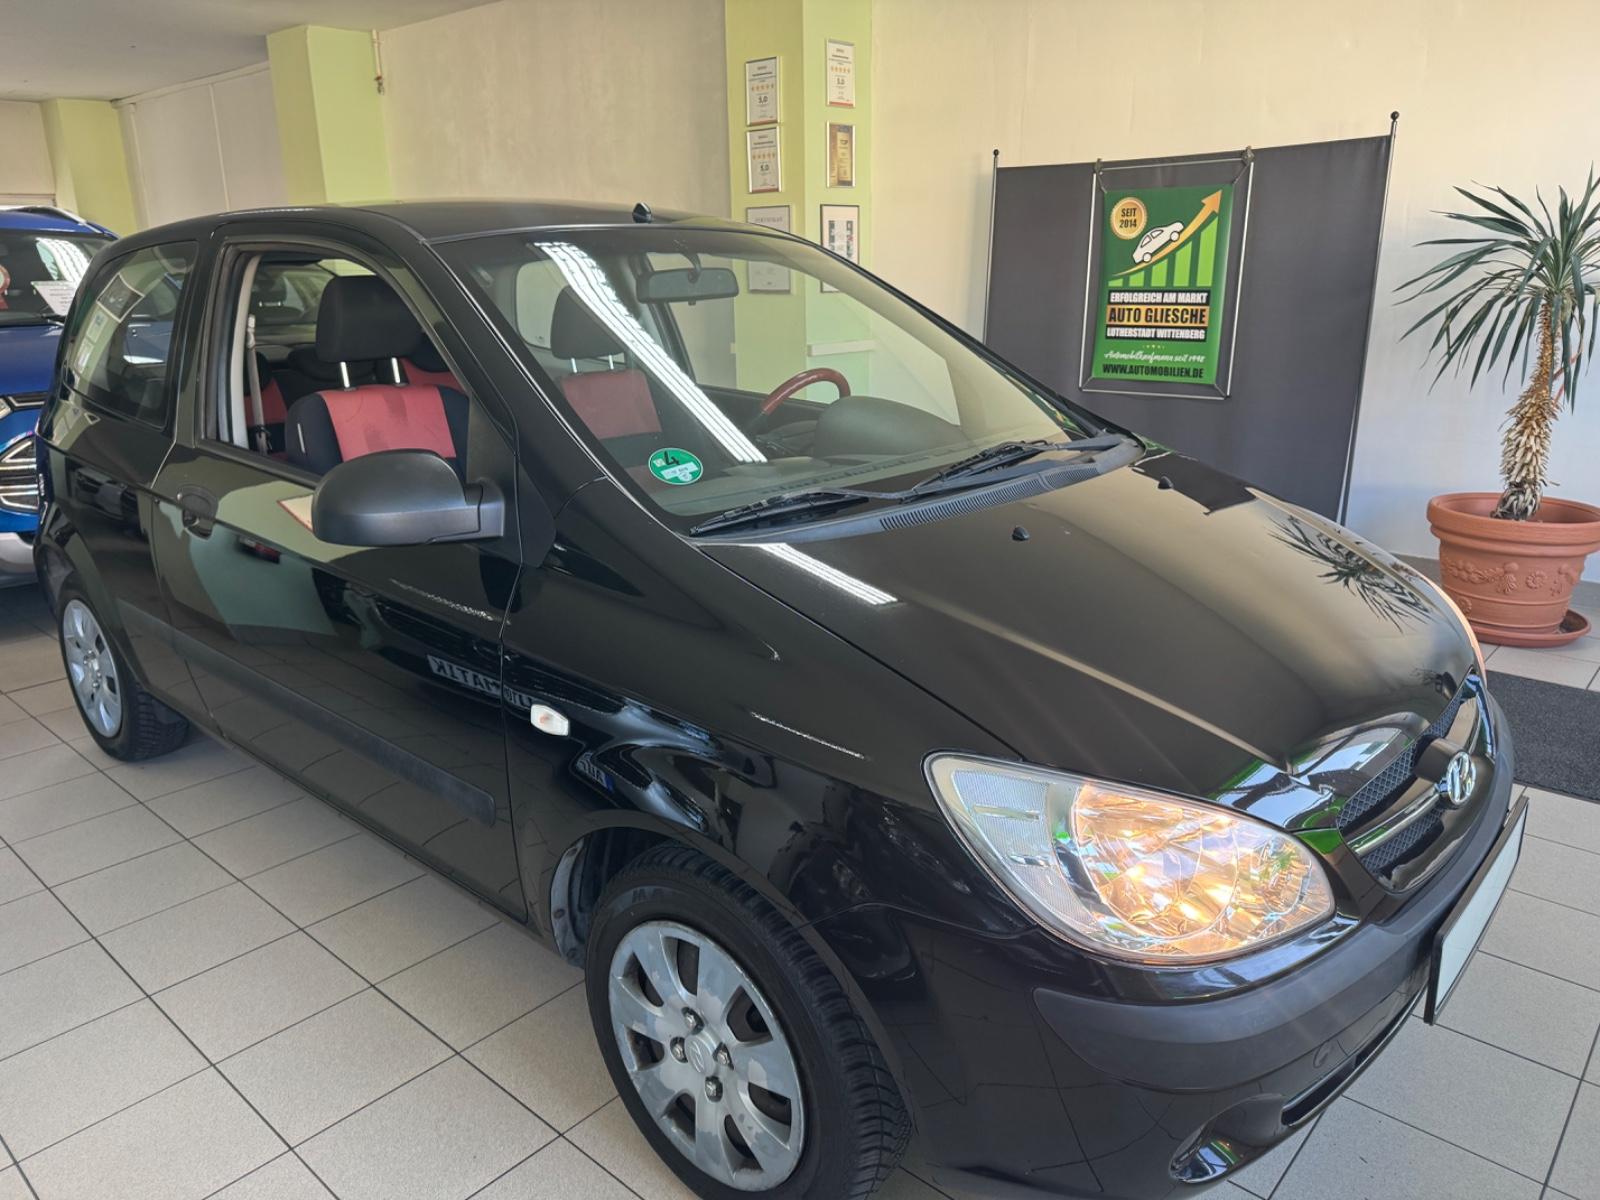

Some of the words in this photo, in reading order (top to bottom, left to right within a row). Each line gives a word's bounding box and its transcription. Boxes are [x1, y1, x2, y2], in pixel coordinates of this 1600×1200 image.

[1121, 208, 1137, 217] SEIT
[1119, 219, 1137, 228] 2014
[1110, 292, 1162, 303] ERFOLGREICH
[1162, 292, 1177, 303] AM
[1177, 293, 1208, 304] MARKT
[1108, 307, 1142, 323] AUTO
[1144, 307, 1207, 324] GLIESCHE
[1106, 327, 1155, 338] LUTHERSTADT
[1156, 329, 1206, 340] WITTENBERG
[1174, 353, 1188, 362] seit
[1102, 363, 1204, 378] WWW.AUTOMOBILIEN.DE
